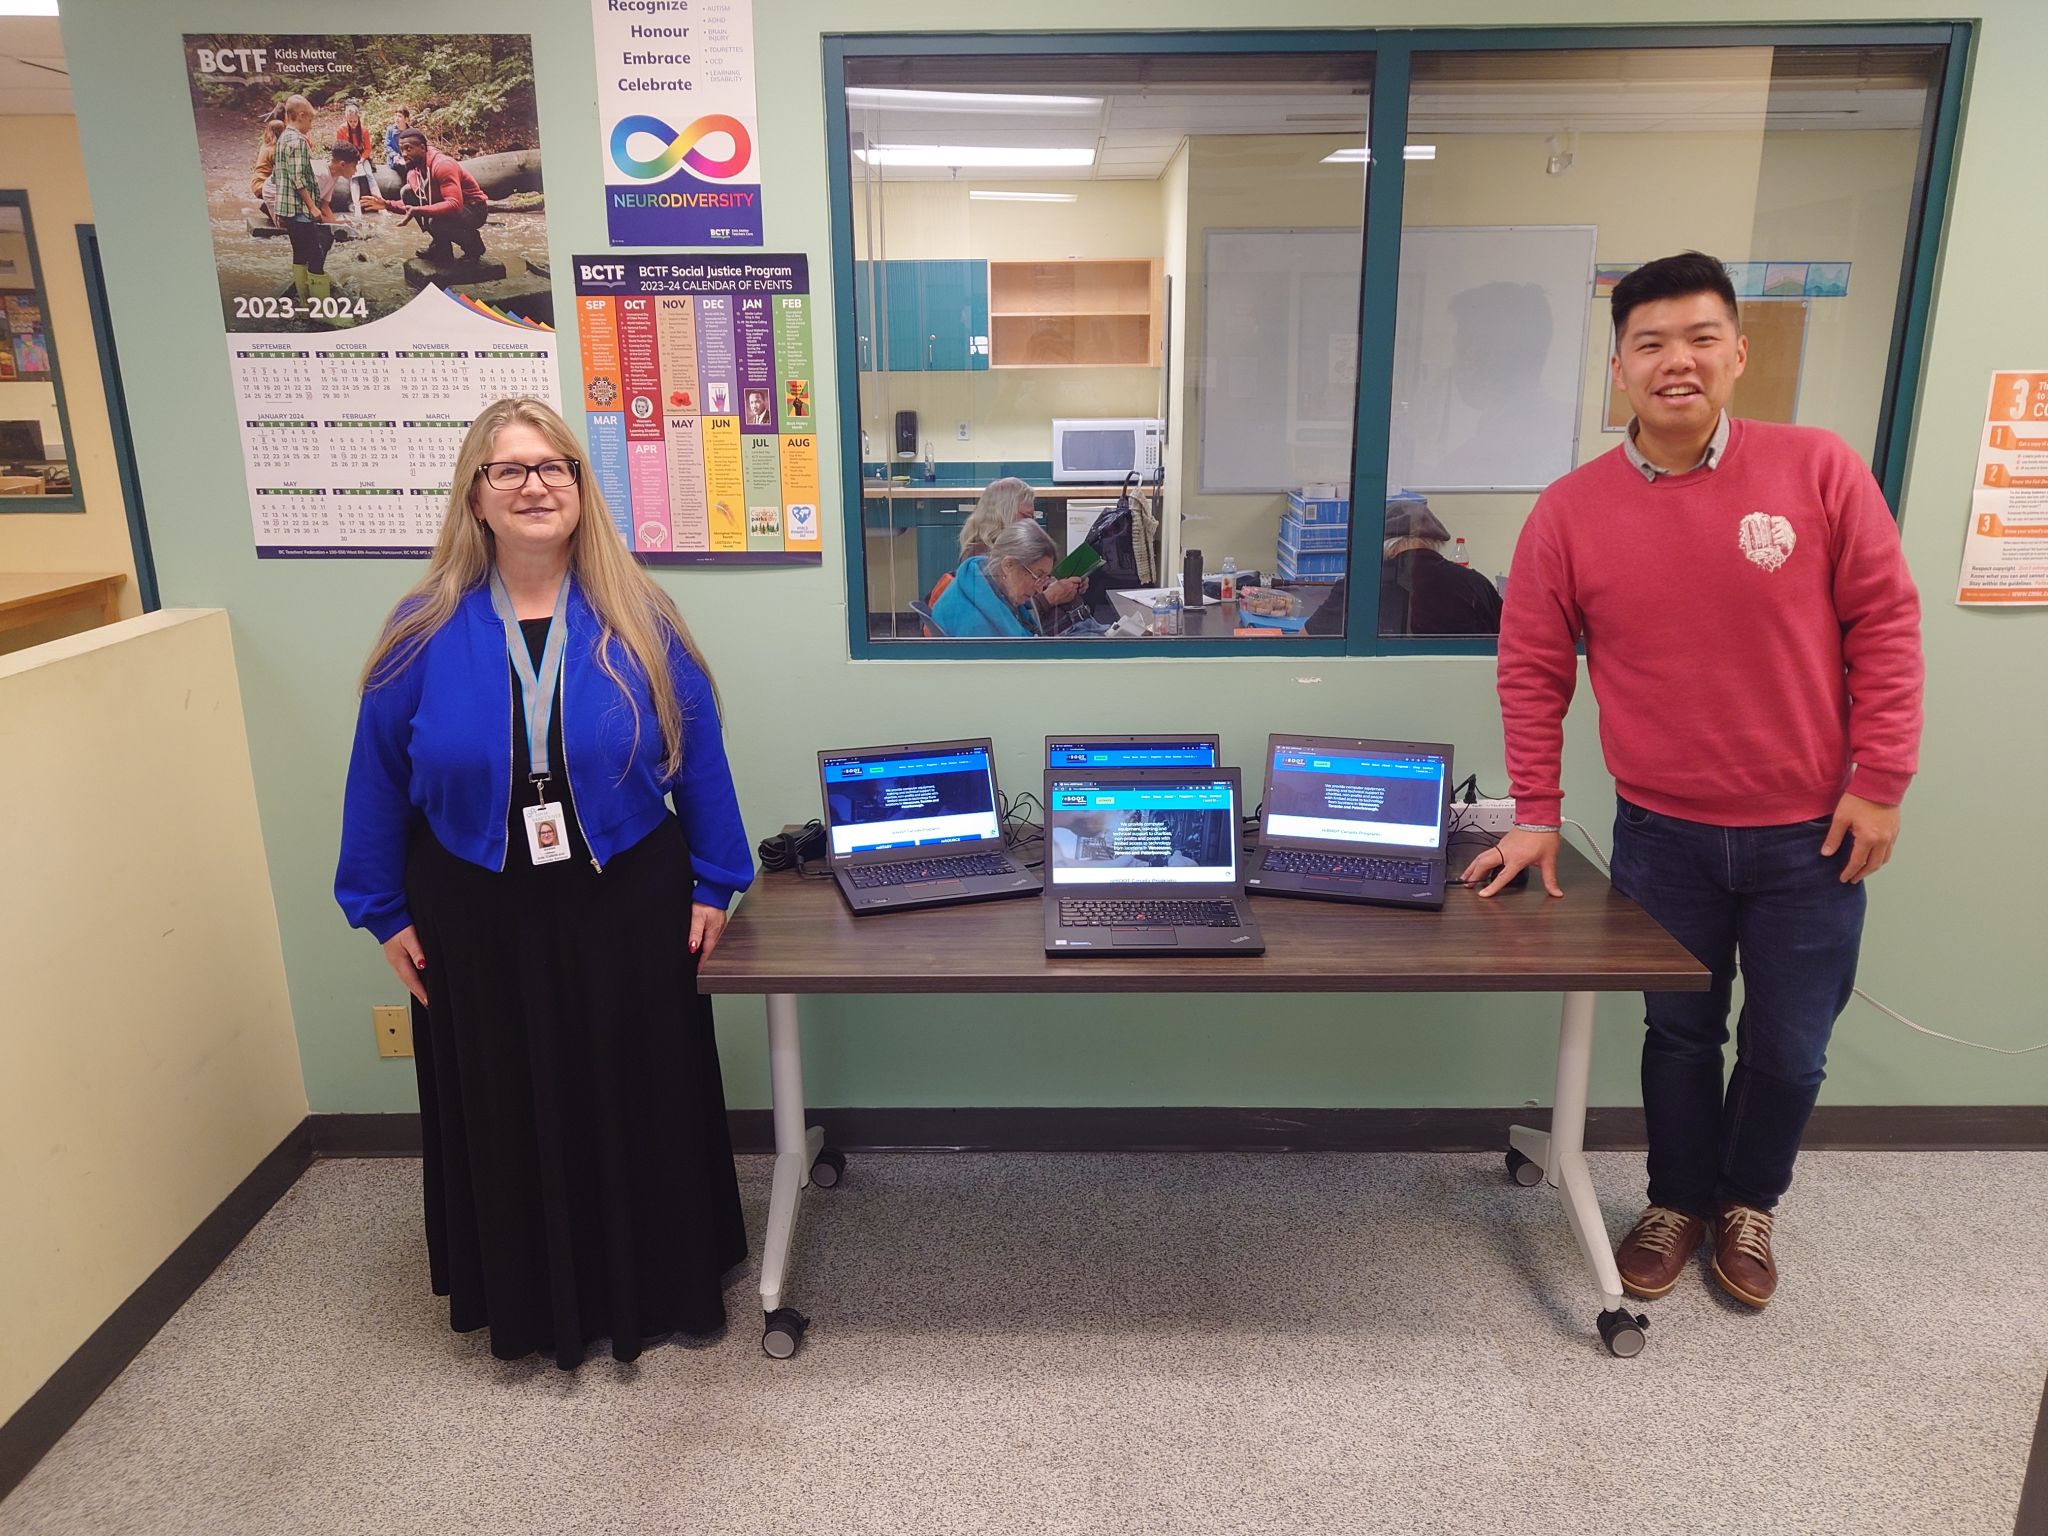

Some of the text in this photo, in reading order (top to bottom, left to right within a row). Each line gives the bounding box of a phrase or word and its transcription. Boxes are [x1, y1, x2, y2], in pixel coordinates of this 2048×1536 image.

[608, 0, 688, 14] Recognize
[631, 25, 690, 38] Honour
[274, 49, 336, 60] Kids Matter
[623, 51, 691, 64] Embrace
[198, 49, 267, 74] BCTF
[276, 62, 352, 73] Teachers Care
[618, 78, 692, 90] Celebrate
[614, 193, 754, 208] NEURODIVERSITY
[581, 265, 624, 280] BCTF
[639, 265, 792, 279] BCTF Social Justice Program
[682, 281, 736, 290] CALENDAR
[738, 281, 752, 290] OF
[754, 280, 792, 290] EVENTS
[586, 300, 606, 310] SEP
[624, 300, 646, 310] OCT
[662, 300, 686, 309] NOV
[702, 300, 724, 309] DEC
[742, 299, 762, 310] JAN
[782, 299, 802, 308] FEB
[2010, 378, 2029, 419] 3
[2037, 392, 2045, 400] to
[594, 416, 618, 424] MAR
[672, 420, 694, 428] MAY
[712, 420, 730, 430] JUN
[1996, 428, 2002, 444] 1
[752, 439, 769, 448] JUL
[788, 438, 810, 447] AUG
[636, 444, 657, 454] APR
[1989, 465, 1998, 482] 2
[1982, 515, 1990, 532] 3
